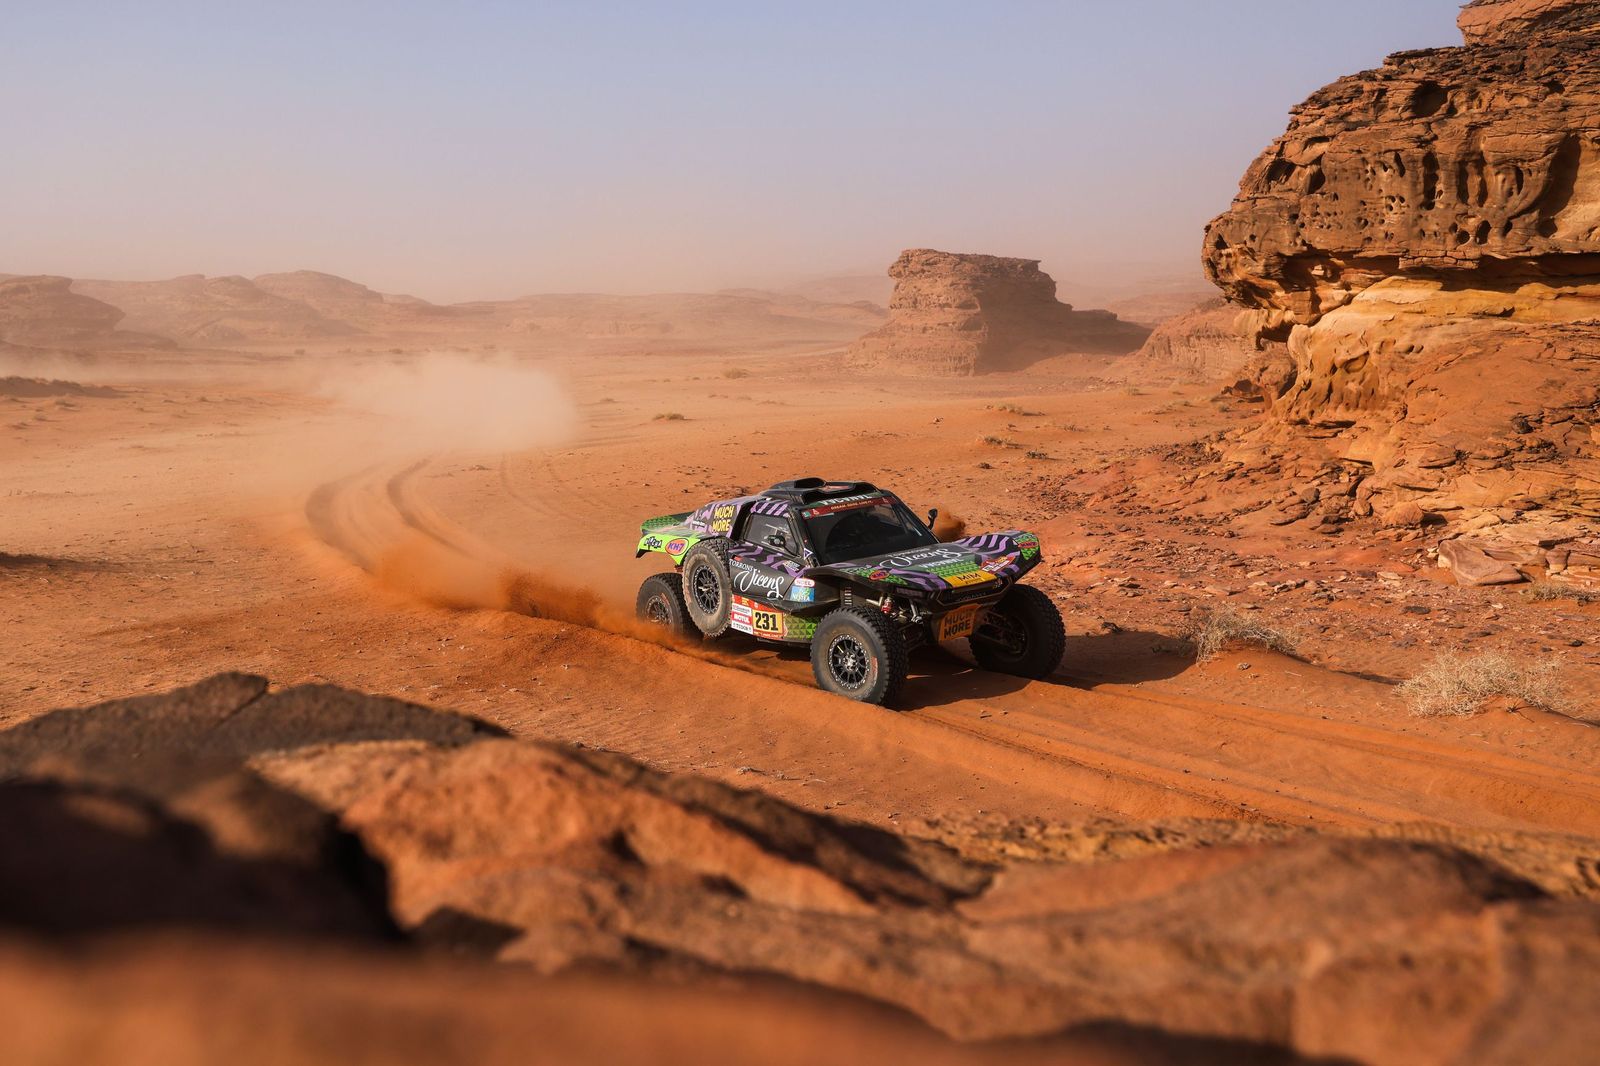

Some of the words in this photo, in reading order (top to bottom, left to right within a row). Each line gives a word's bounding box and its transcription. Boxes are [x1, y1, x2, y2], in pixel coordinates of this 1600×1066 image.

[713, 505, 735, 519] MUCH
[712, 519, 731, 532] MORE
[668, 542, 686, 552] KH7
[729, 559, 754, 572] TORRONS
[734, 568, 785, 598] Vicens
[755, 612, 779, 631] 231
[944, 608, 973, 626] MUCH
[944, 620, 971, 638] MORE
